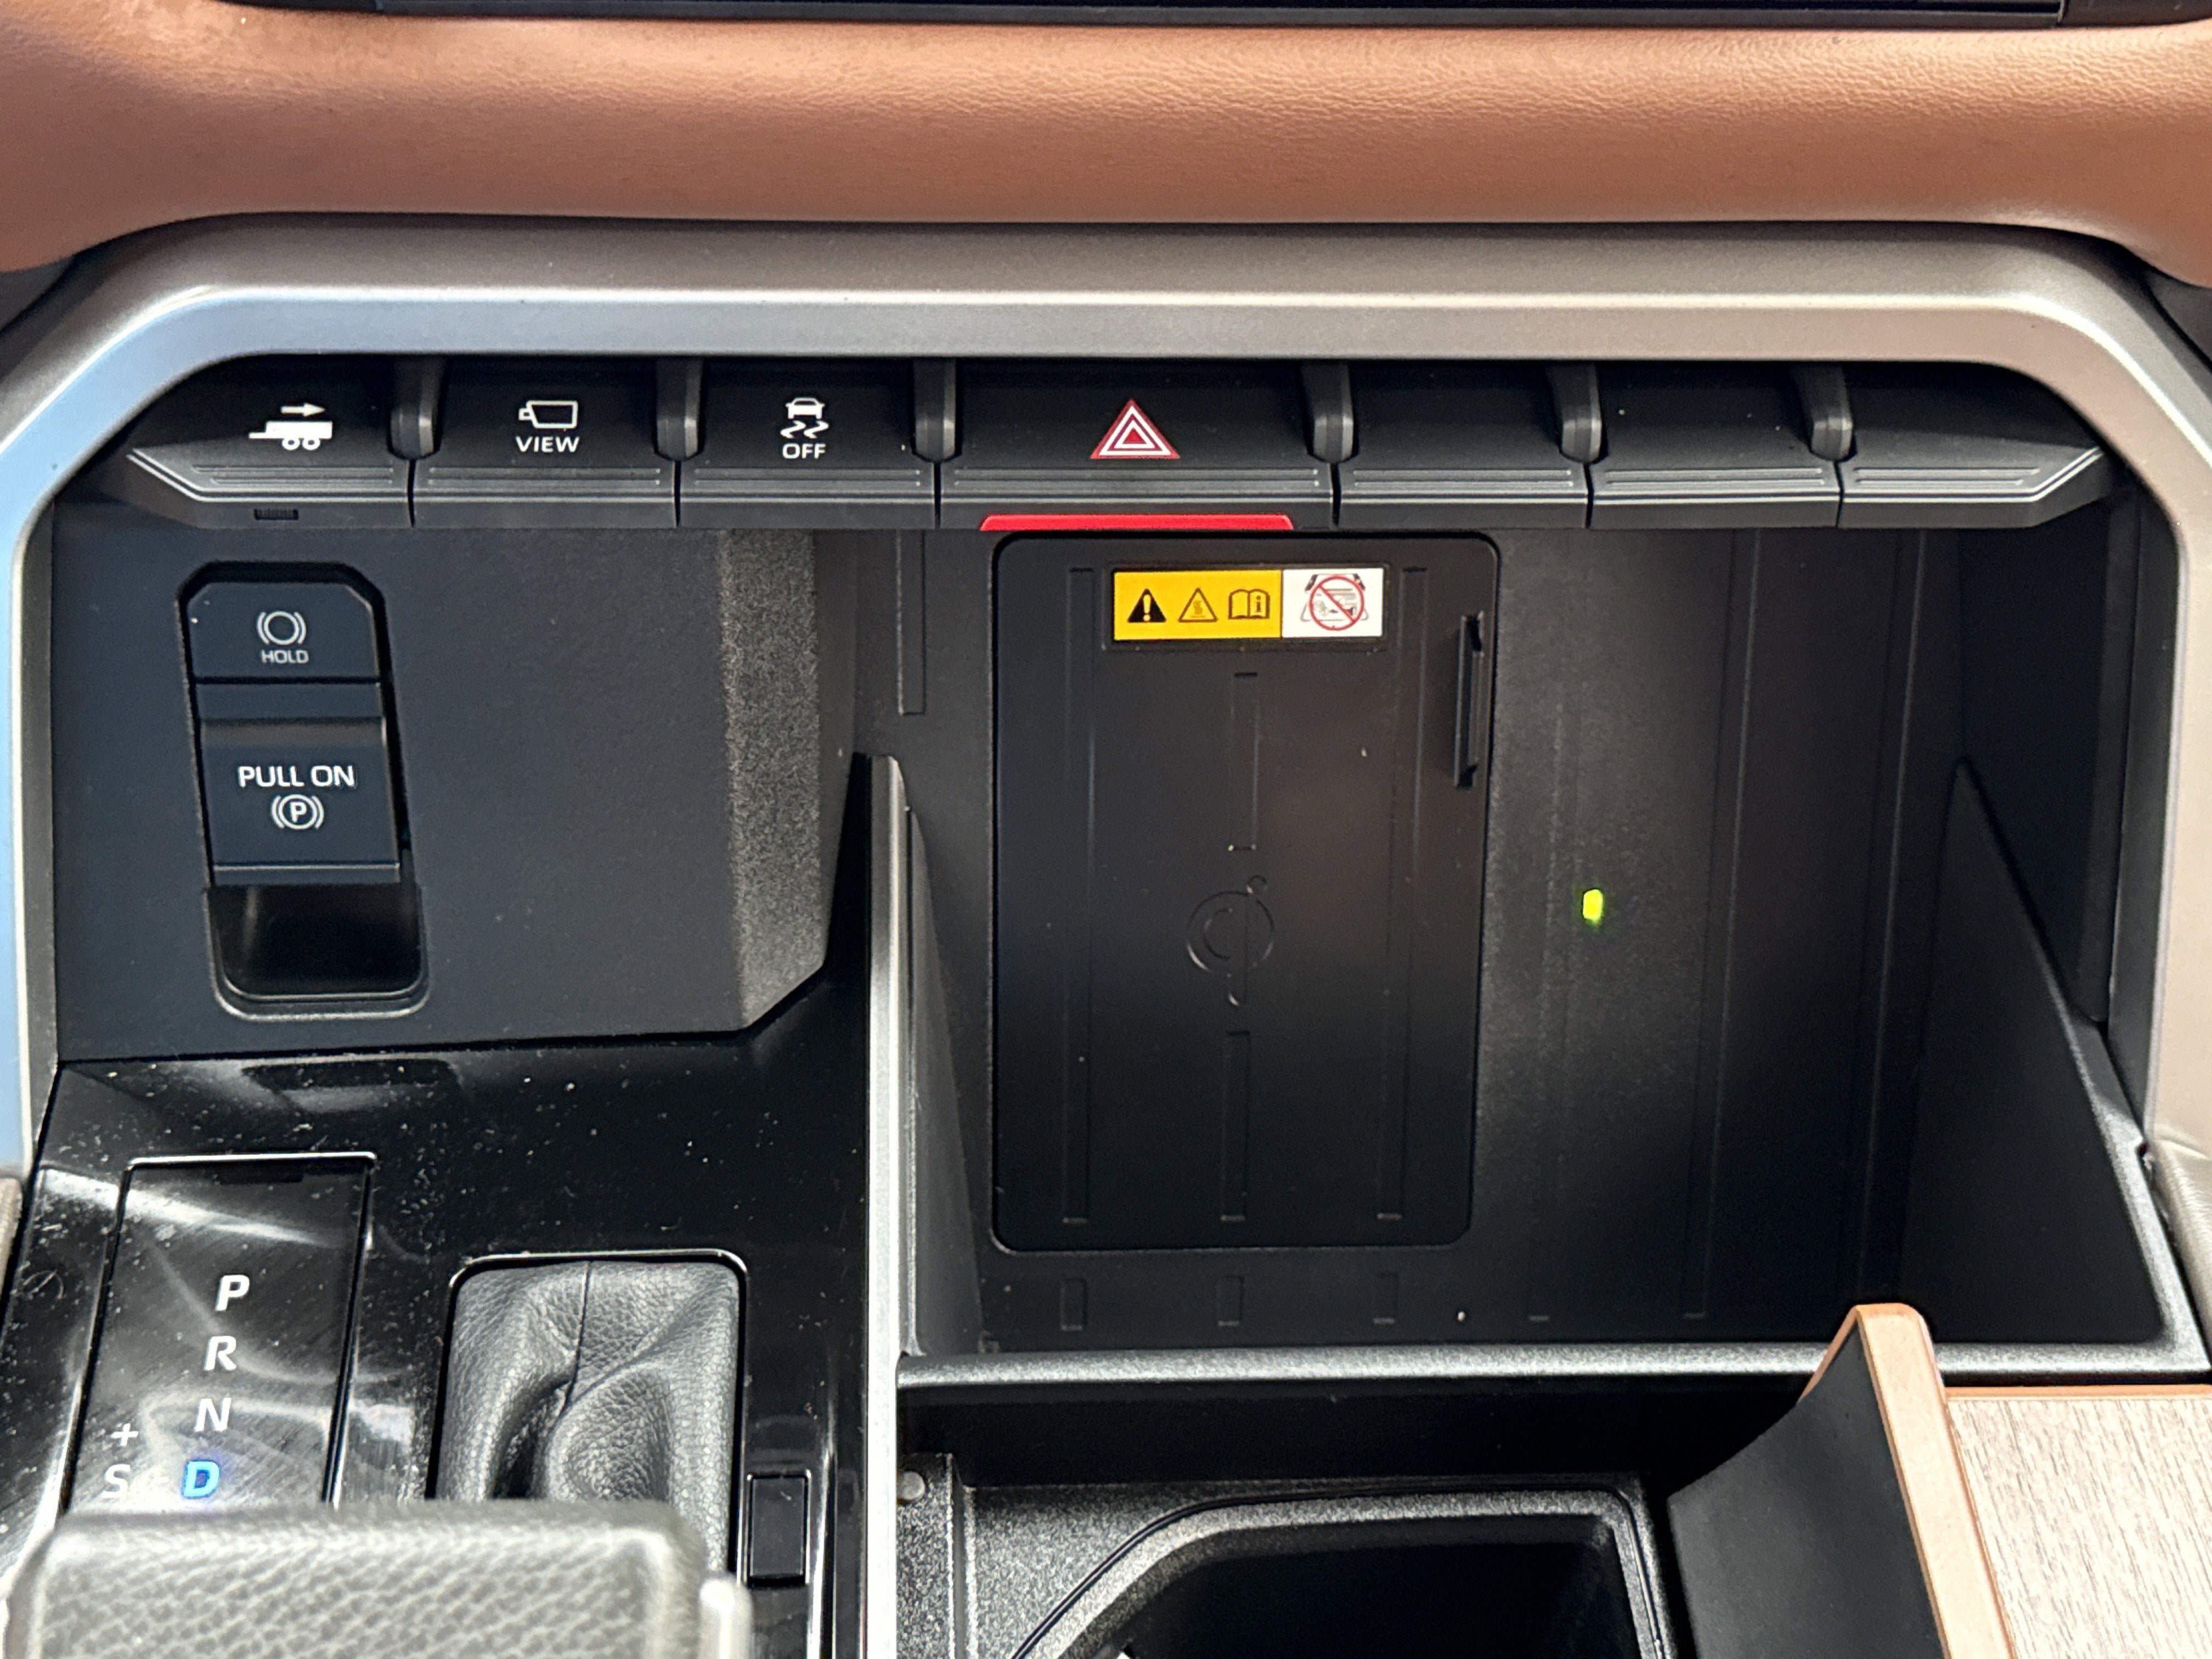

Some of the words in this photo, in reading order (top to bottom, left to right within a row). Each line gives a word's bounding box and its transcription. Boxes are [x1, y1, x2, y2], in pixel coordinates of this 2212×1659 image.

[516, 436, 580, 453] VIEW
[782, 443, 826, 459] OFF
[261, 650, 309, 664] HOLD
[238, 765, 304, 787] PULL
[311, 765, 355, 787] ON
[215, 1274, 250, 1311] P
[204, 1335, 237, 1371] R
[193, 1397, 232, 1432] N
[101, 1464, 131, 1499] S
[181, 1459, 220, 1499] D
